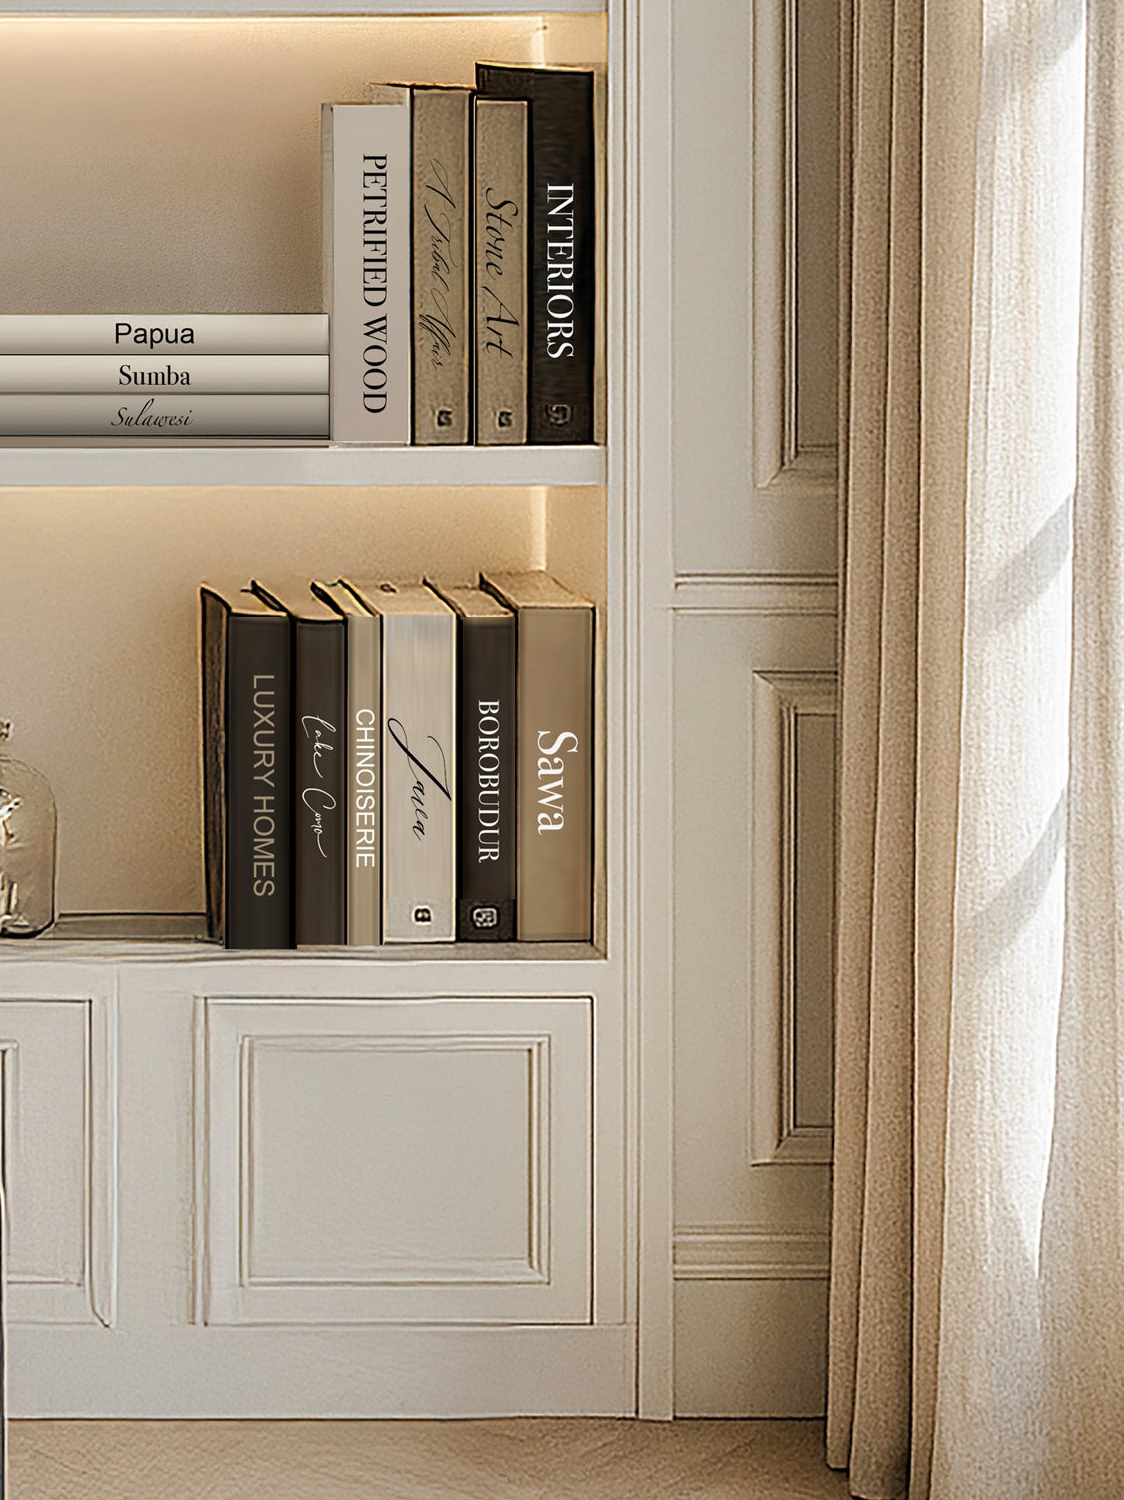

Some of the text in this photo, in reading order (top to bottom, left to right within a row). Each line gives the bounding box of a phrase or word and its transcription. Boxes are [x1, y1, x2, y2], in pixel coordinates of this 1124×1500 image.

[362, 153, 388, 414] PETRIFIED WOOD
[423, 203, 459, 292] Tribal
[483, 188, 520, 359] Stone Art
[546, 183, 574, 359] INTERIORS
[115, 323, 195, 349] Papua
[119, 364, 192, 386] Sumba
[111, 398, 194, 427] Sulawesi
[252, 674, 275, 897] LUXURY HOMES
[301, 714, 337, 859] Lake Como
[355, 708, 375, 868] CHINOISERIE
[387, 717, 452, 842] Java
[478, 700, 501, 863] BOROBUDUR
[537, 730, 579, 835] Sawa
